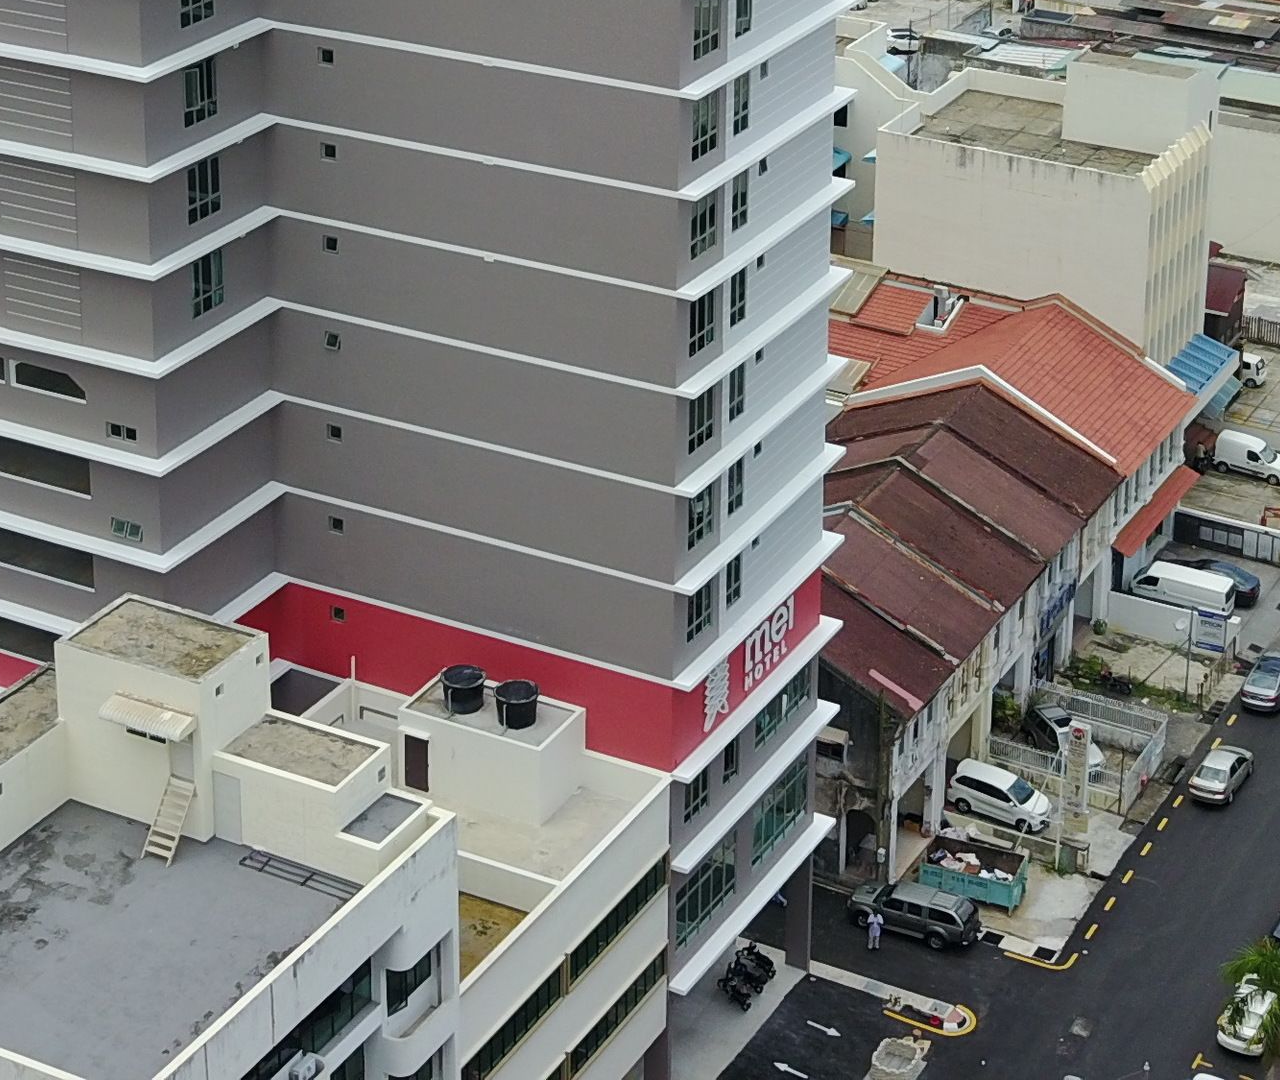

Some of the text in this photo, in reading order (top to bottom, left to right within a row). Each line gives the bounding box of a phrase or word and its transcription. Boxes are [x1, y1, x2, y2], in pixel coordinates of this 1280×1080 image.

[744, 594, 795, 673] mei
[1200, 619, 1223, 629] EPSON
[744, 640, 788, 692] HOTEL
